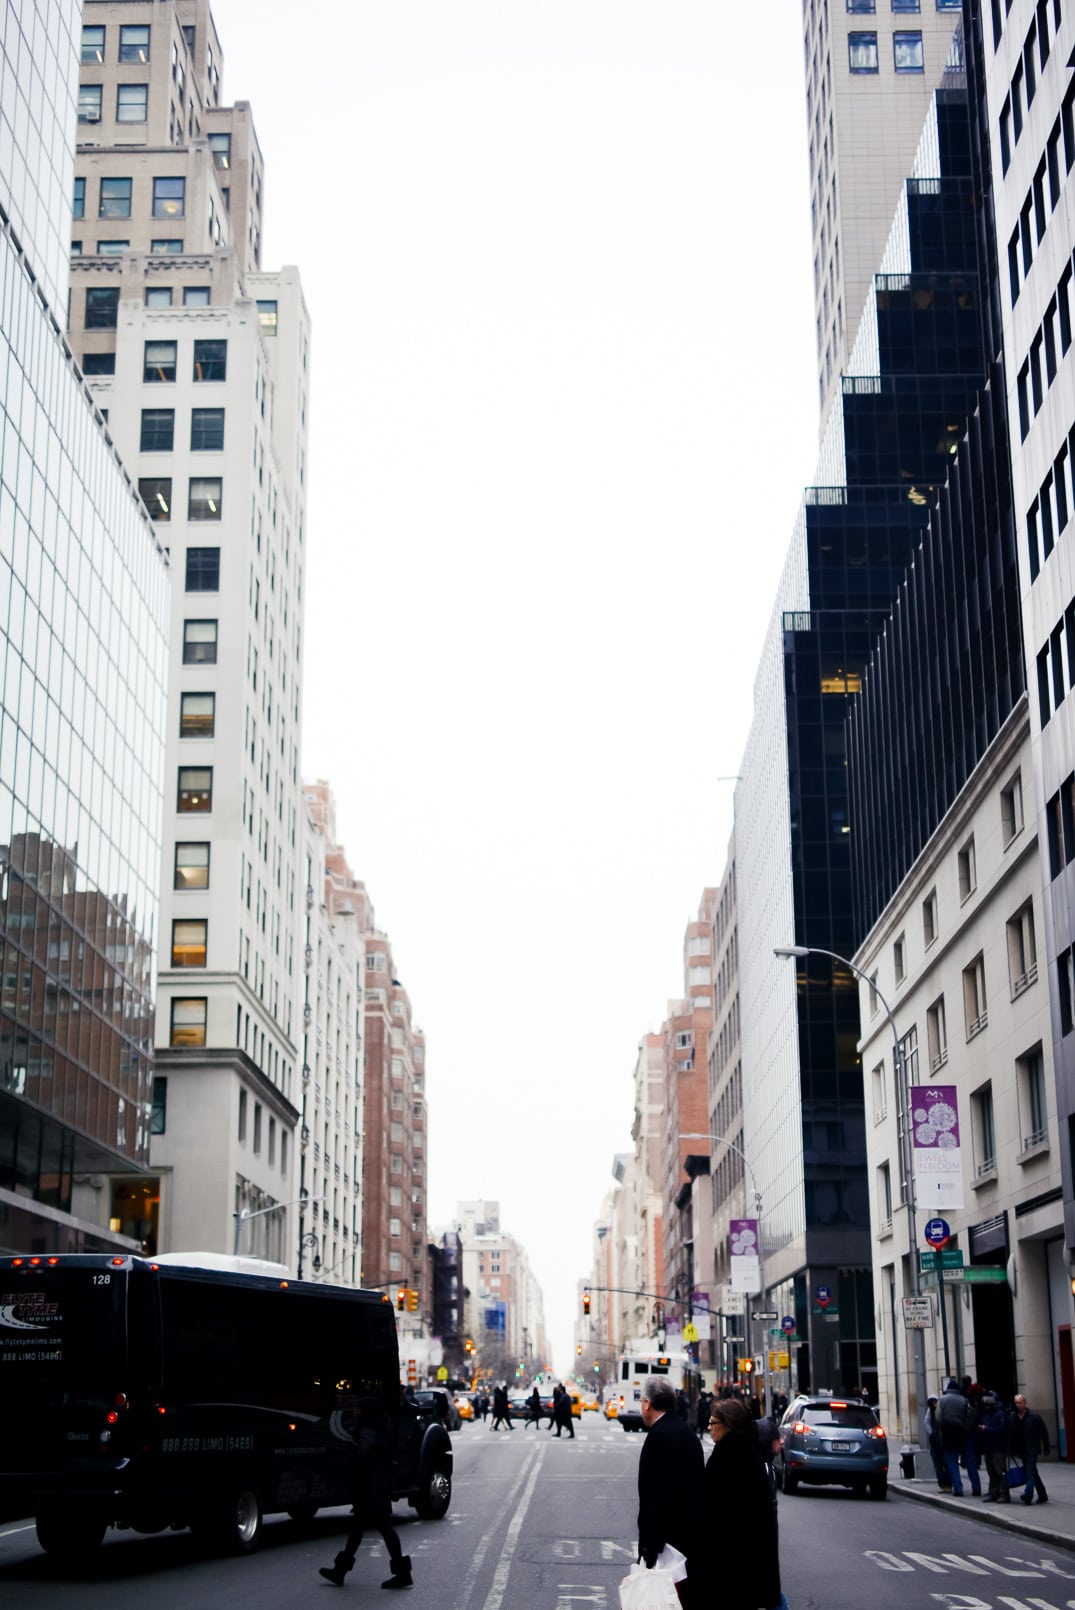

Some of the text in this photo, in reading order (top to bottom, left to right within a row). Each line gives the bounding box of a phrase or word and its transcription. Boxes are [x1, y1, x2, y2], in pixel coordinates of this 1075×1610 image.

[93, 1274, 111, 1285] 128
[2, 1292, 45, 1306] FLYTE
[18, 1303, 59, 1316] TYME
[19, 1352, 36, 1361] LIMO
[202, 1436, 224, 1452] LIMO
